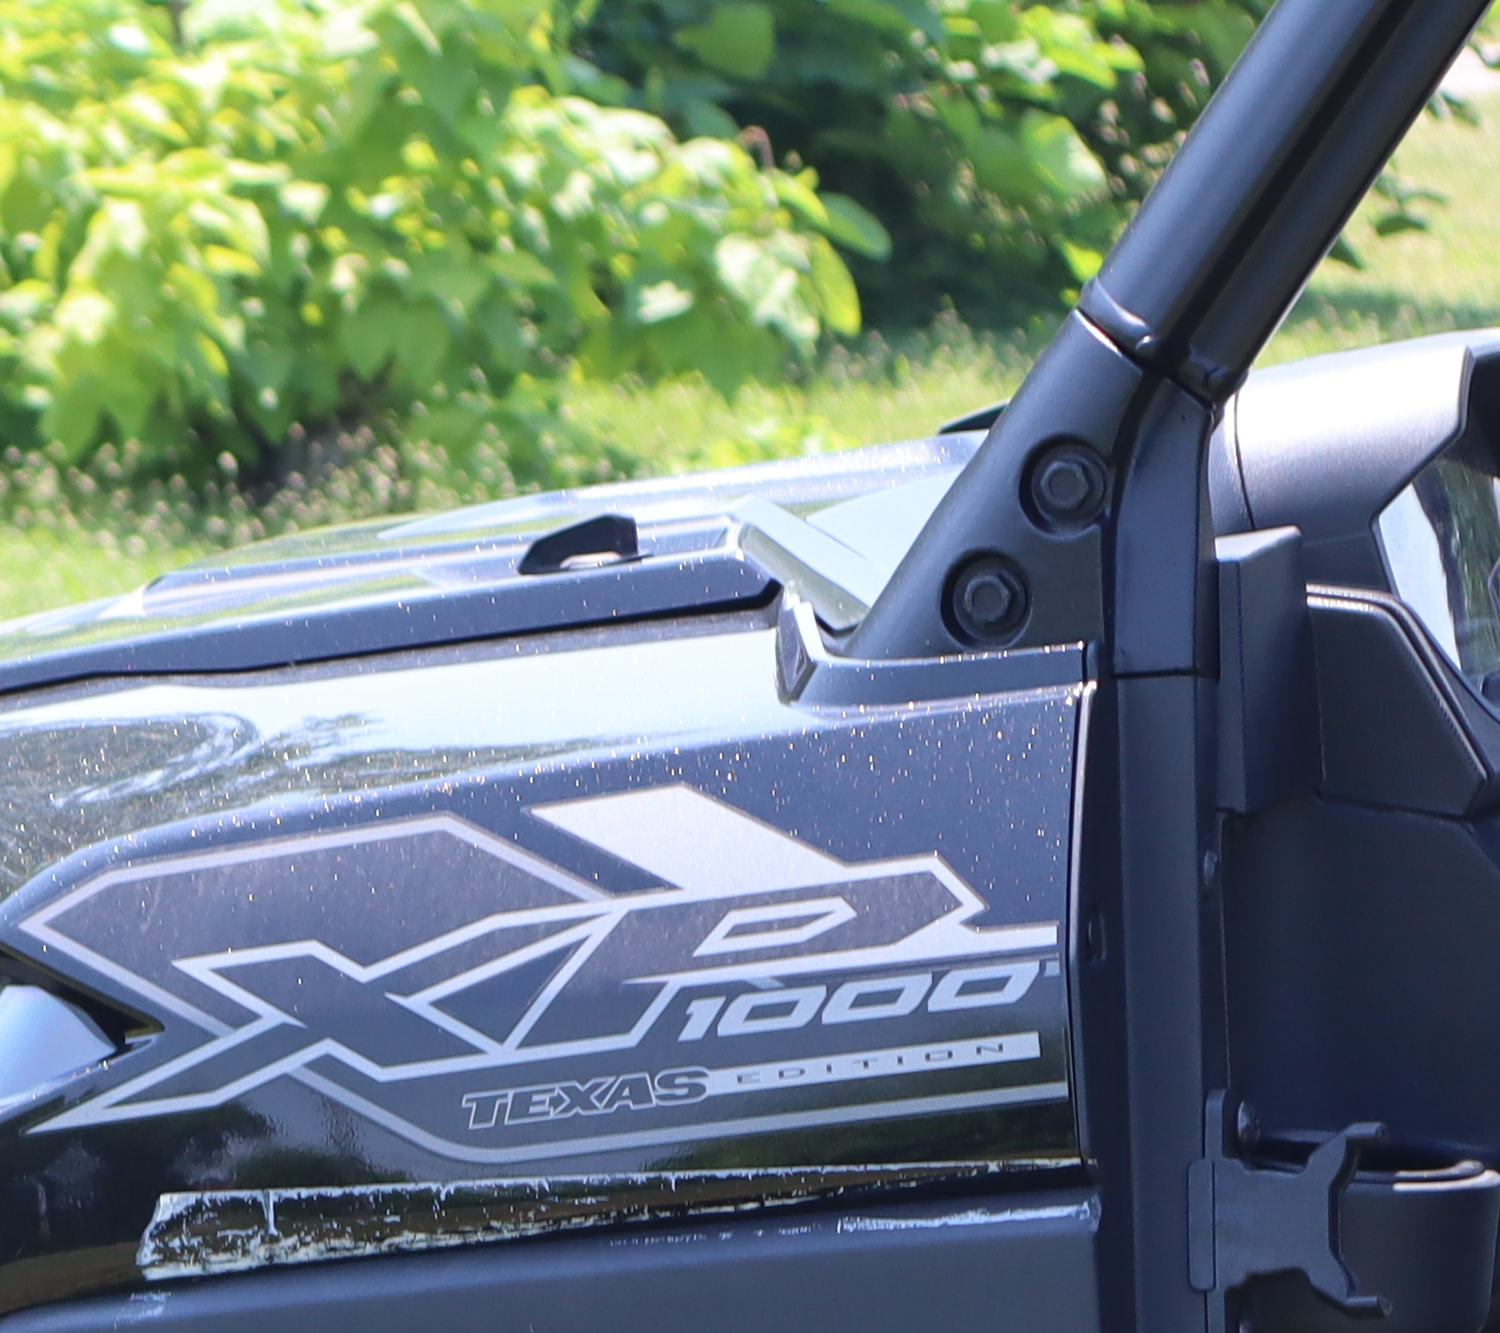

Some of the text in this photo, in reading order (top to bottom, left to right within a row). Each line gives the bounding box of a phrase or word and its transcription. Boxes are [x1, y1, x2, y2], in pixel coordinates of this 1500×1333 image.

[676, 960, 1041, 1042] 1000
[460, 1041, 1005, 1130] TEXAS EDITION
